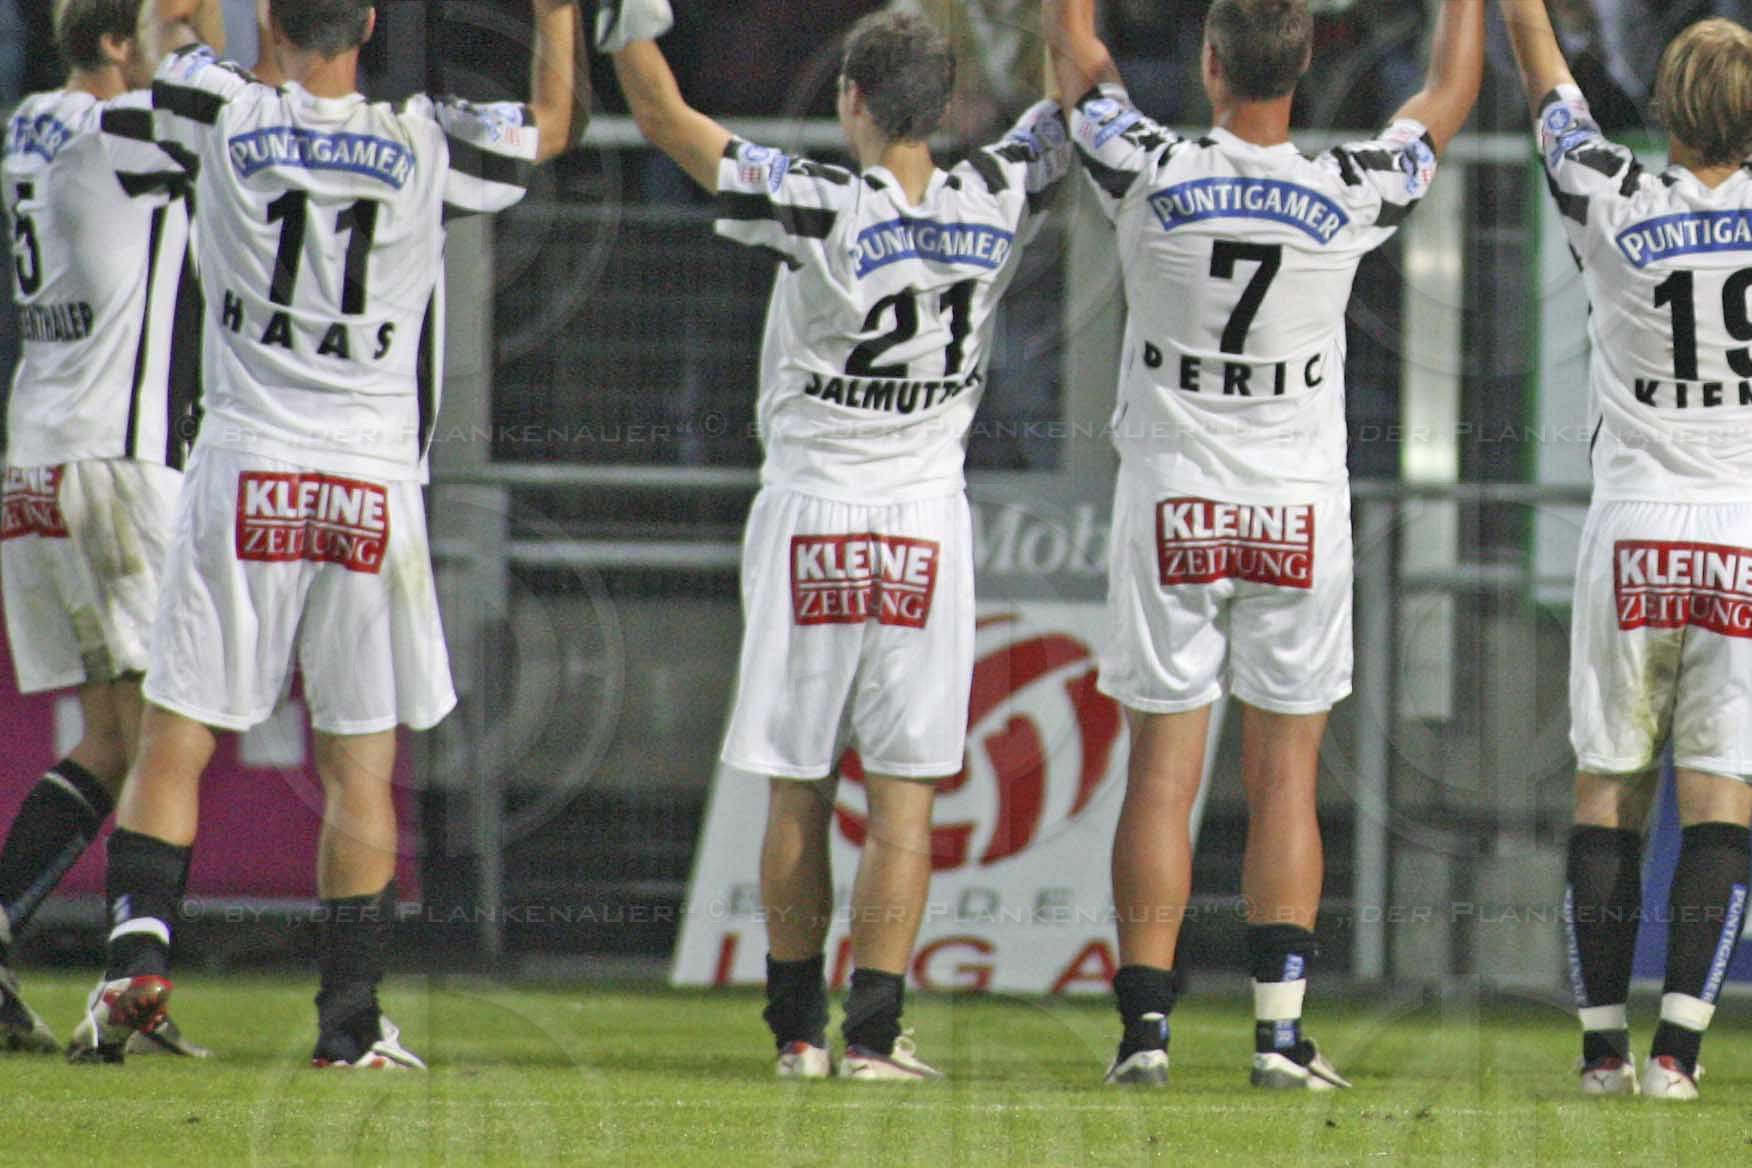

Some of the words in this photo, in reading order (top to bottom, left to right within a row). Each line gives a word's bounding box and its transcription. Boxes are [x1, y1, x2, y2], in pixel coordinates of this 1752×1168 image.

[1153, 184, 1341, 240] PUNTIGAMER
[266, 189, 380, 315] 11
[848, 225, 1010, 271] PUNTGAMER
[1209, 239, 1283, 355] 7
[222, 288, 395, 360] HAAS
[844, 278, 978, 379] 21
[245, 479, 385, 531] KLEINE
[1163, 502, 1309, 543] KLEINE
[797, 540, 933, 585] KLEINE
[1165, 546, 1308, 580] ZEITUNG
[799, 588, 926, 620] ZEITNG
